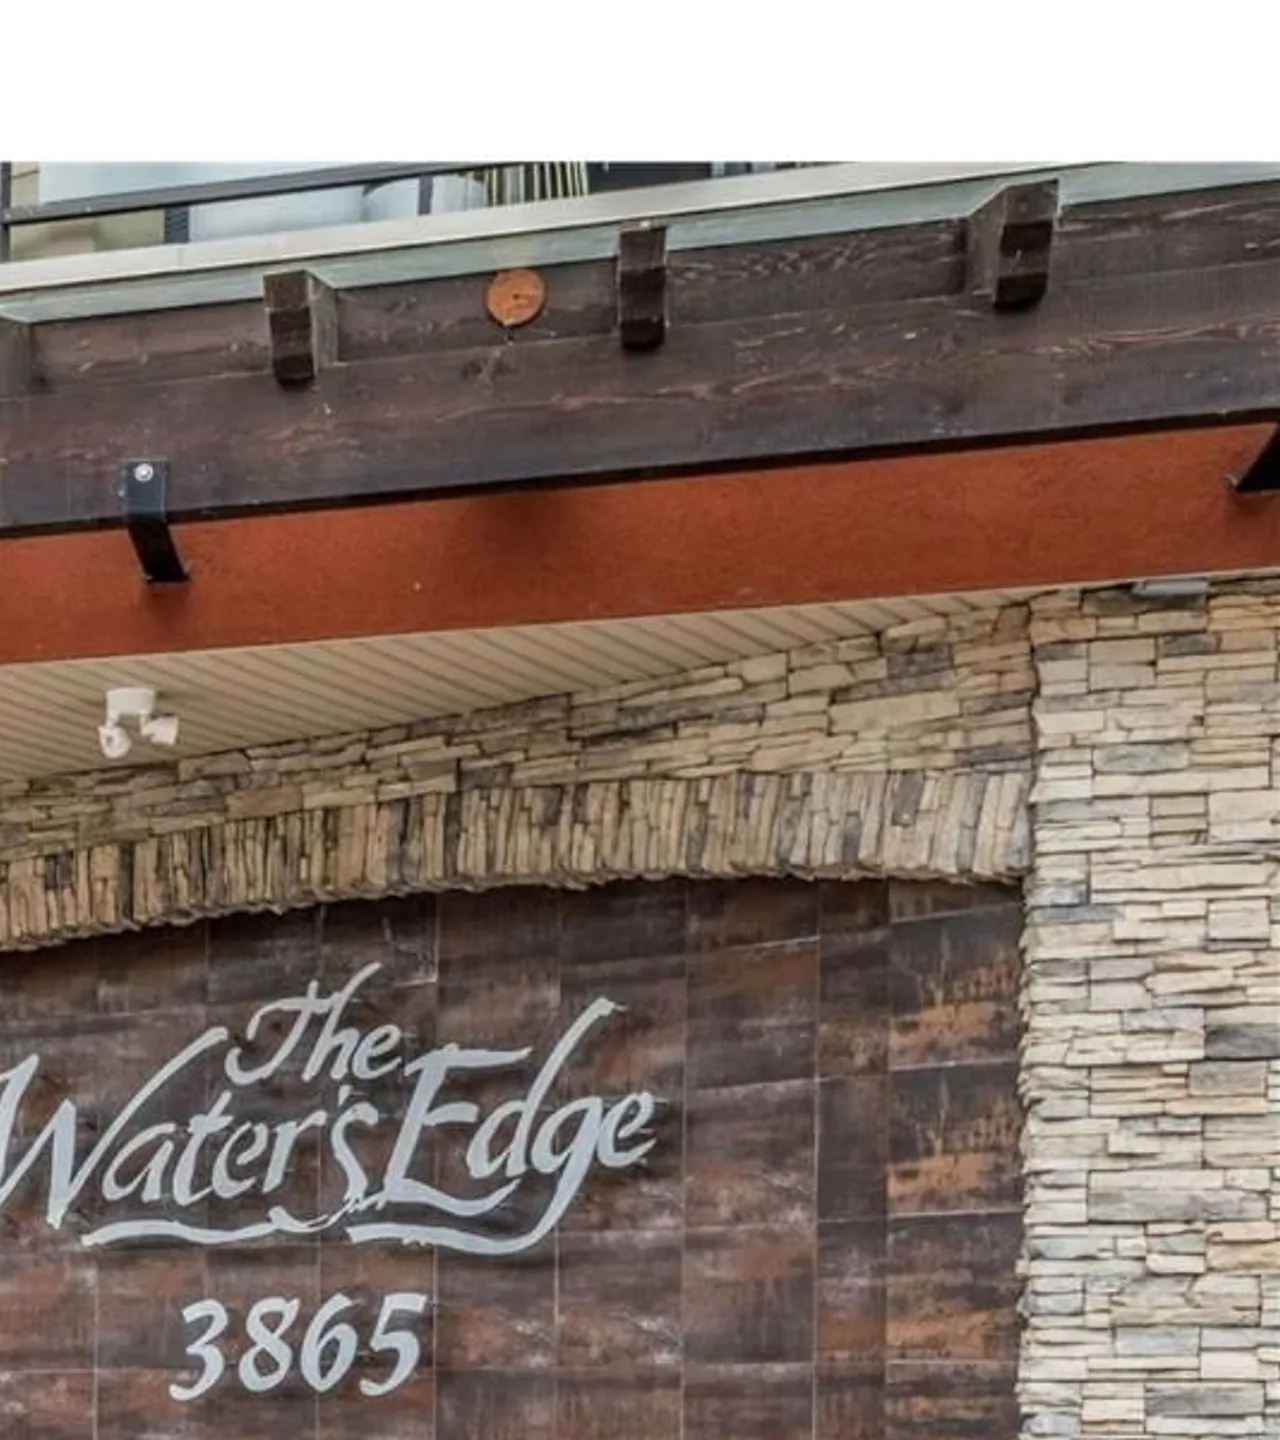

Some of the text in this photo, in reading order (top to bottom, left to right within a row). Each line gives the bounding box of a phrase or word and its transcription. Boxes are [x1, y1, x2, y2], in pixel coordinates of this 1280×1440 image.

[224, 961, 402, 1086] The
[348, 998, 659, 1256] Edge
[169, 1292, 428, 1400] 3865
